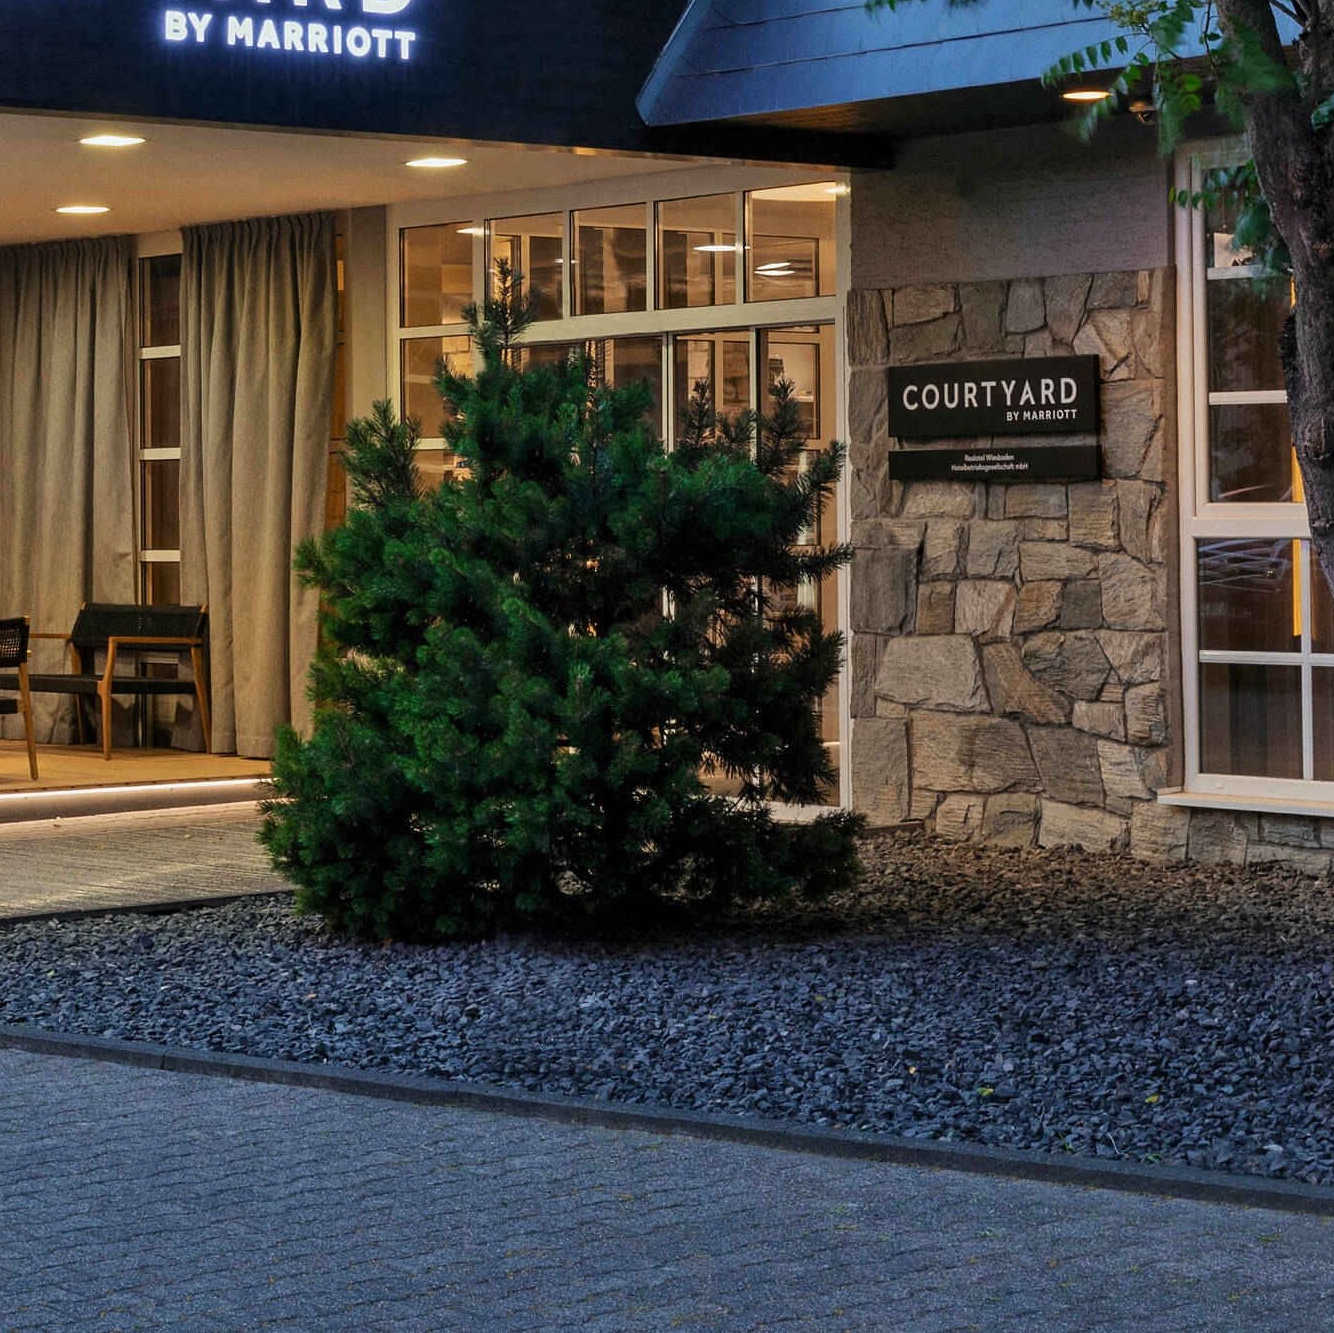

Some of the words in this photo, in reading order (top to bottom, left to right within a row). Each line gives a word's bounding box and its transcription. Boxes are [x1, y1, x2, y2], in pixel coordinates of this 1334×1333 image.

[164, 9, 213, 43] BY
[227, 15, 416, 60] MARRIOTT
[902, 377, 1077, 411] COURTYARD
[1006, 411, 1019, 422] BY
[1023, 409, 1078, 421] MARRIOTT
